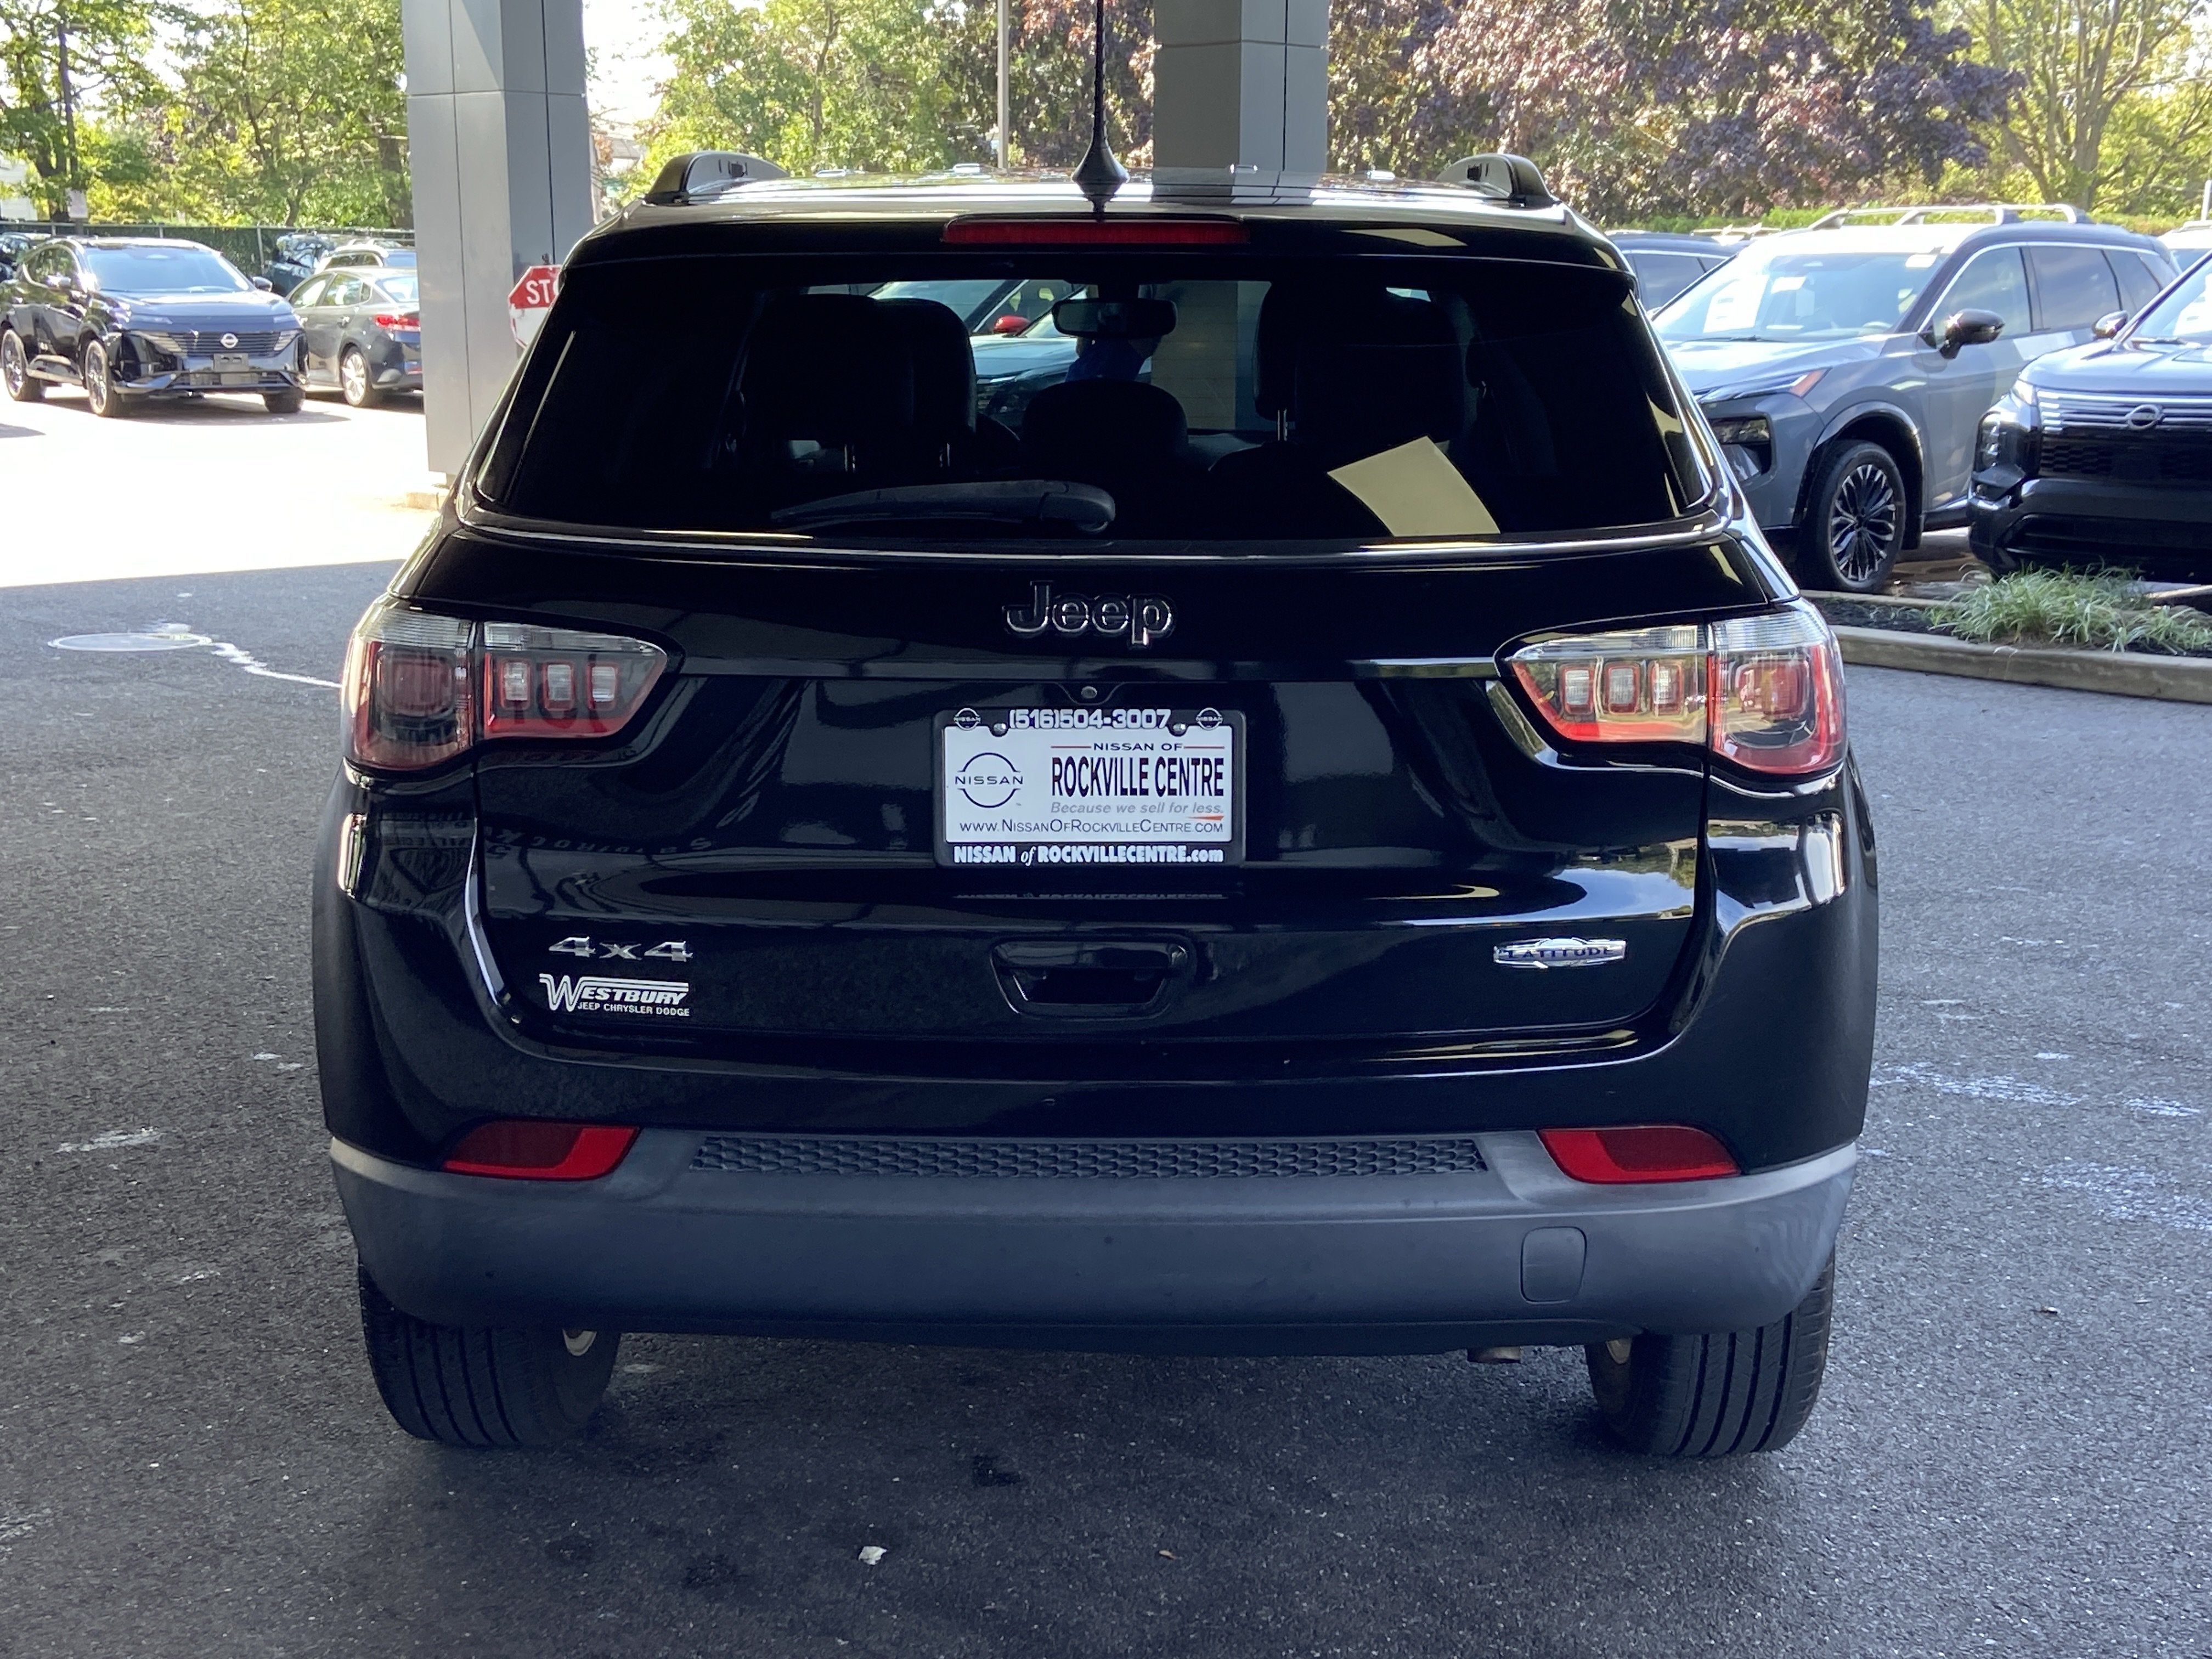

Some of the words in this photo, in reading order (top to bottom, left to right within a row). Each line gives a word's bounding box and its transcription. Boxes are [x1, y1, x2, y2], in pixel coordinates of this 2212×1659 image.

[1001, 580, 1174, 647] Jeep
[1009, 709, 1171, 729] (516)504-3007
[1093, 743, 1154, 751] NISSAN
[1161, 743, 1183, 751] OF
[955, 776, 1023, 785] NISSAN
[1052, 756, 1149, 797] ROCKVILLE
[1155, 756, 1224, 797] CENTRE
[1051, 802, 1111, 813] Because
[1117, 805, 1136, 813] we
[1140, 802, 1164, 813] sell
[1170, 802, 1188, 813] for
[1192, 802, 1223, 813] less.
[954, 845, 1015, 863] NISSAN
[1021, 847, 1036, 866] of
[1038, 845, 1224, 862] ROCKVILLECENTRE.com
[1503, 945, 1615, 959] LATITUDE
[539, 973, 689, 1012] WESTBURY
[578, 1001, 600, 1011] JEEP
[603, 1003, 653, 1014] CHRYSLER
[656, 1007, 690, 1017] DODGE
